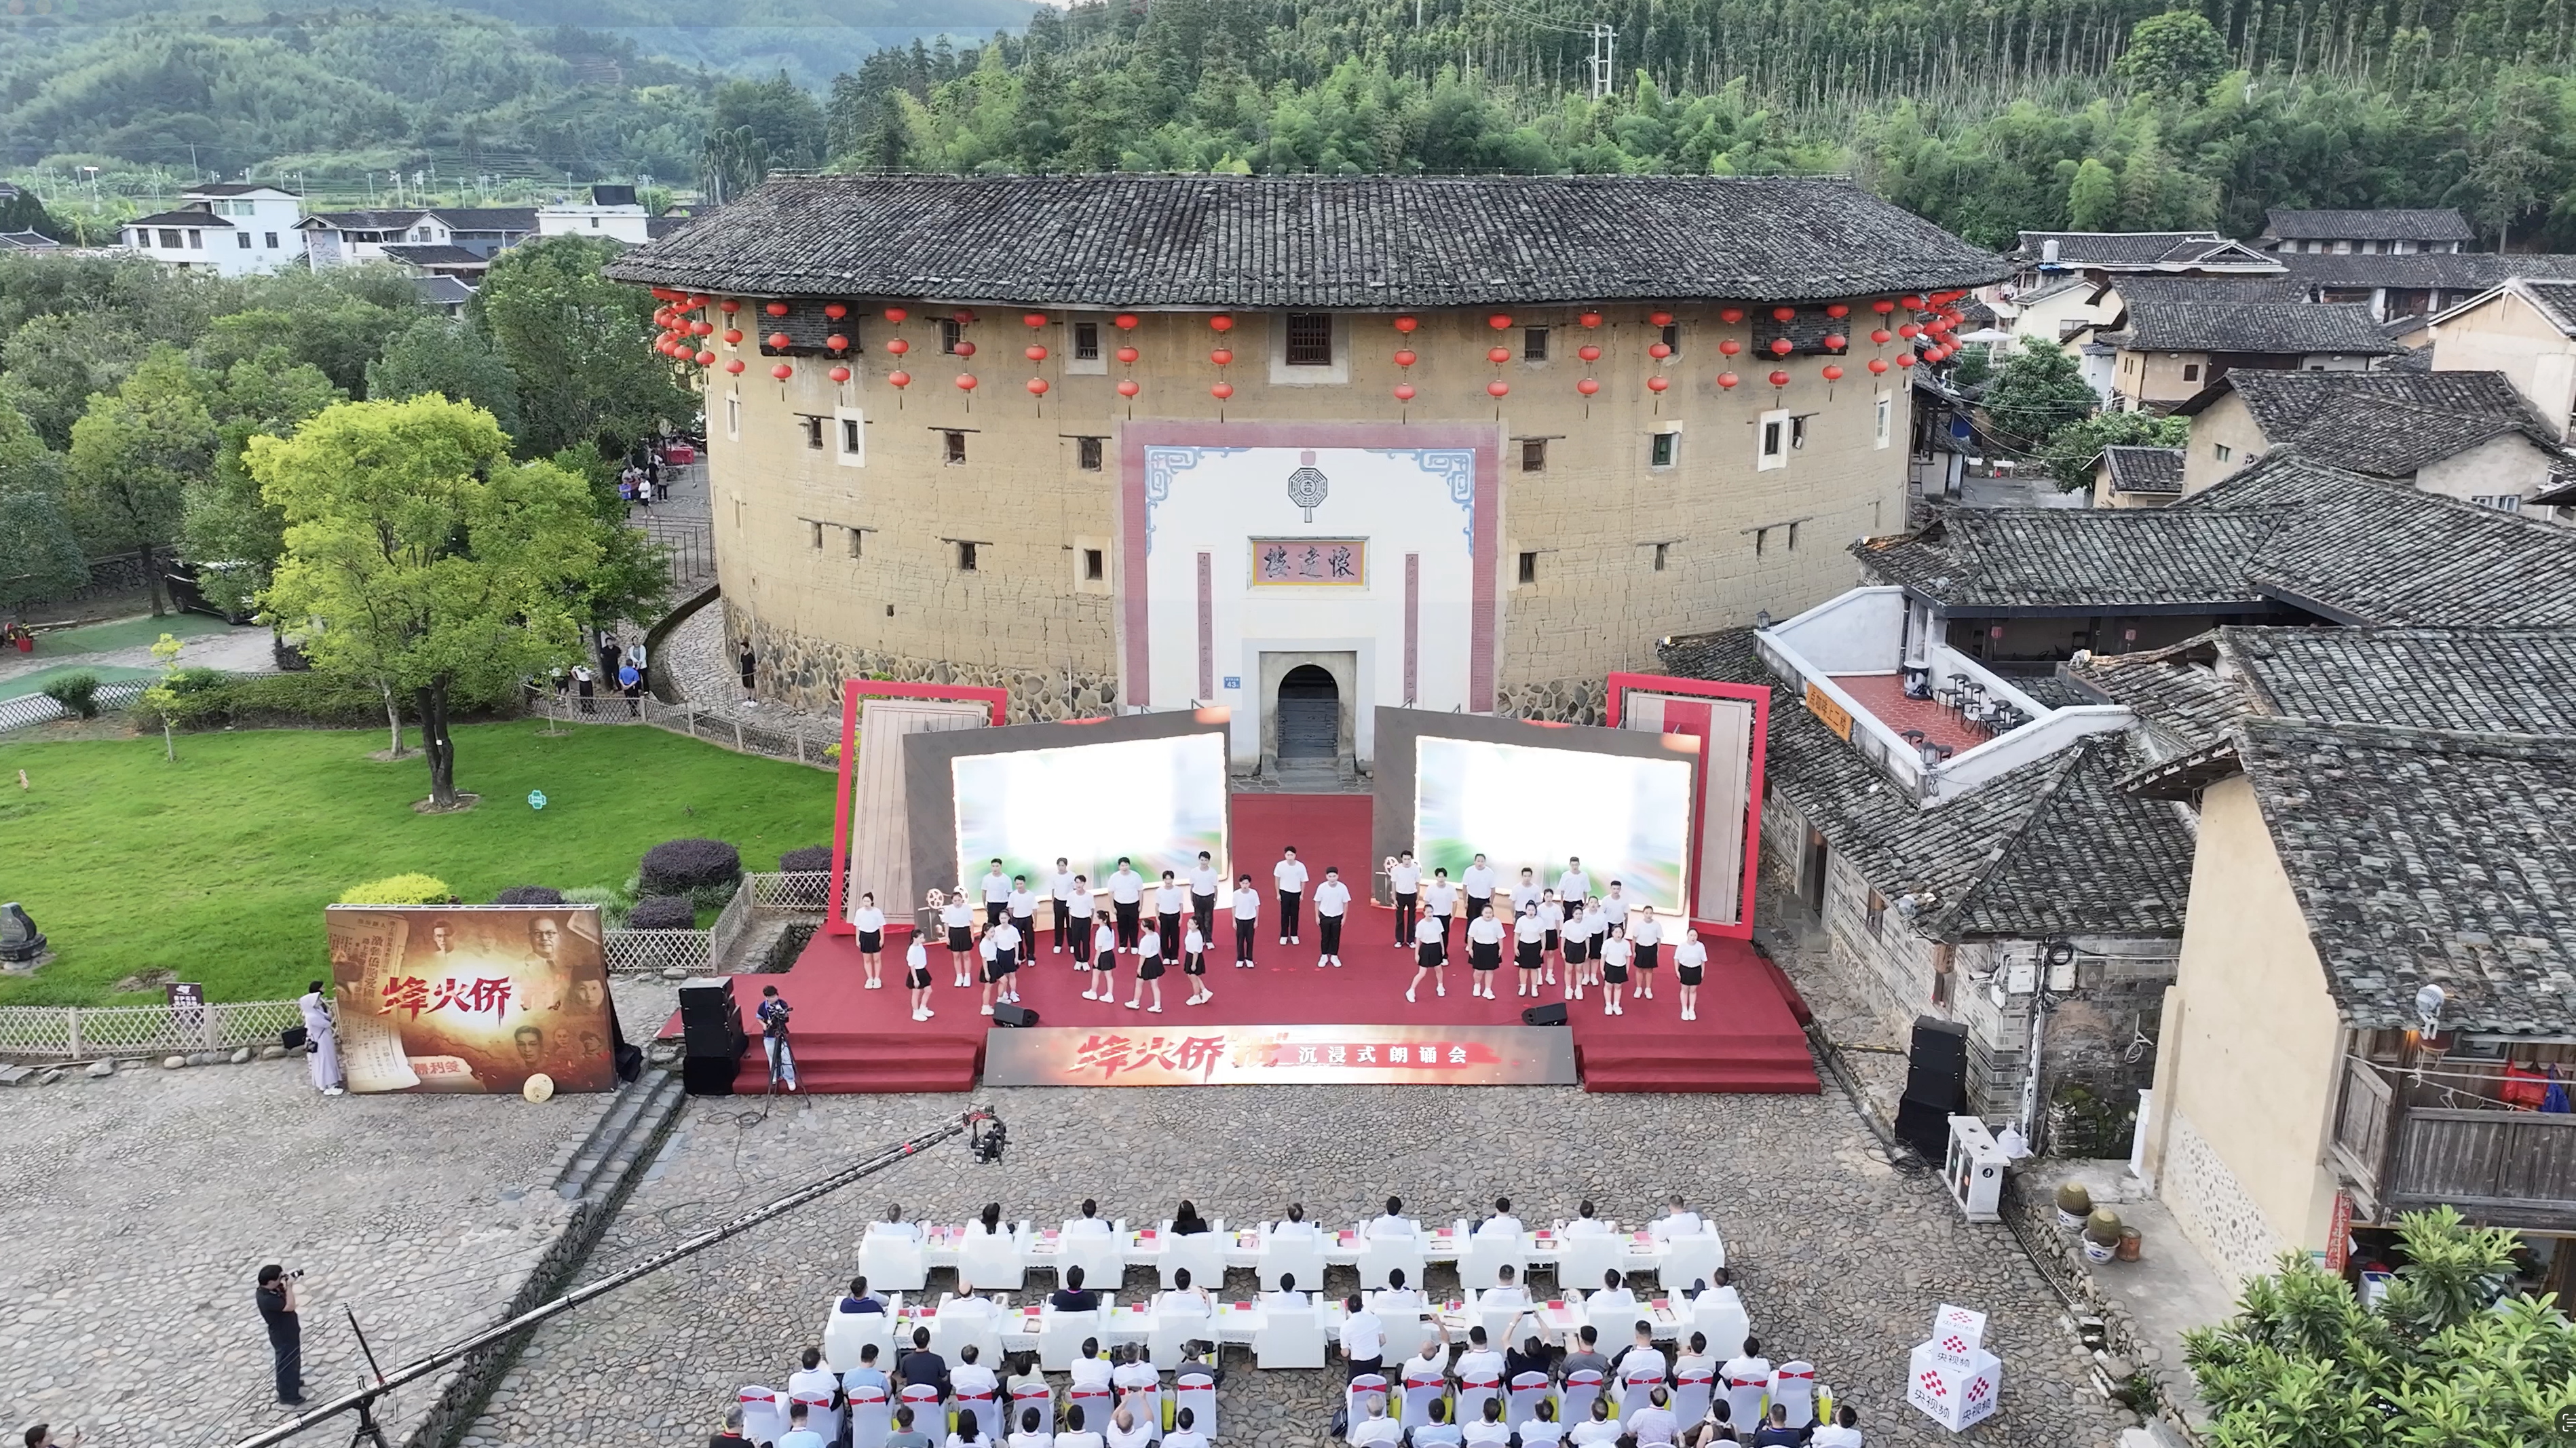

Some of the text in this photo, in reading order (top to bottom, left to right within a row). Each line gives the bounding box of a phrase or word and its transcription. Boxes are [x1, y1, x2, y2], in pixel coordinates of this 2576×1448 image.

[1298, 1046, 1467, 1064] 沉浸式朗诵会
[1937, 1352, 1971, 1368] 央视频
[1914, 1388, 1950, 1420] 央视频
[1962, 1398, 1992, 1423] 央视频
